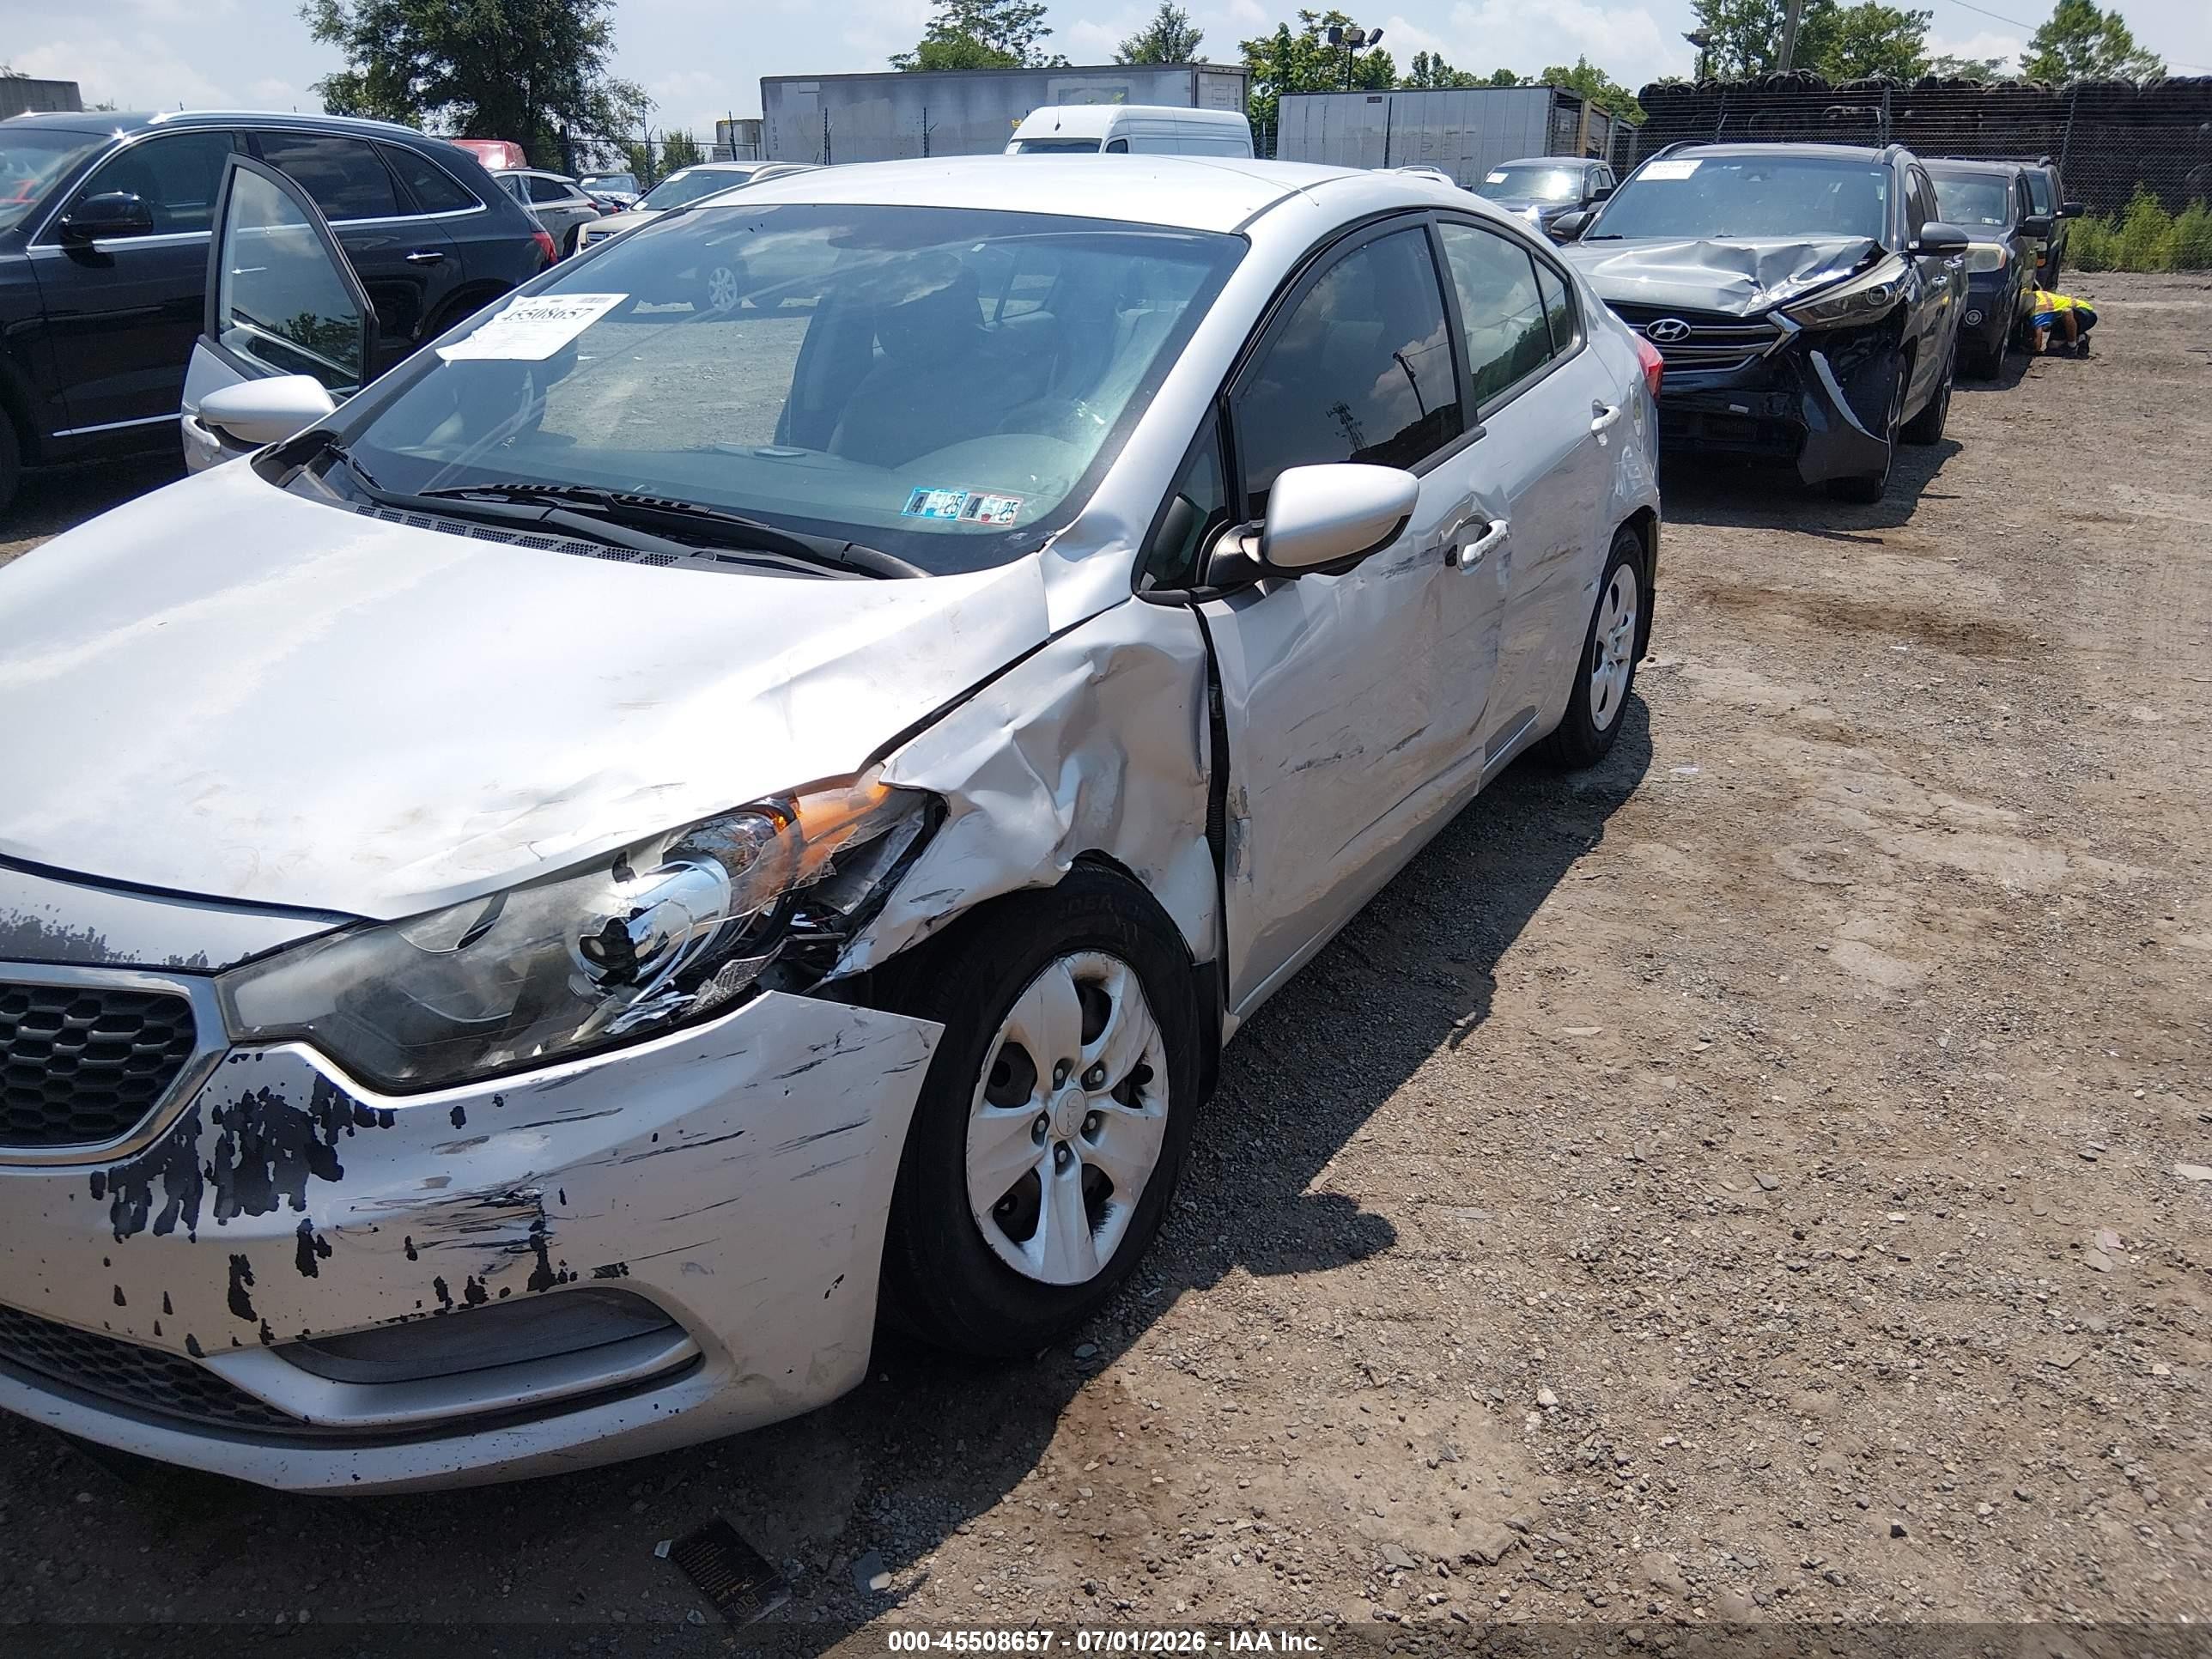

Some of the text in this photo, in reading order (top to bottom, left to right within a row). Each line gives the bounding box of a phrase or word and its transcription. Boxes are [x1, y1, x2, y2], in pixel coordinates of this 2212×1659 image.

[911, 495, 963, 514] 4 25
[967, 497, 1018, 522] 4 25
